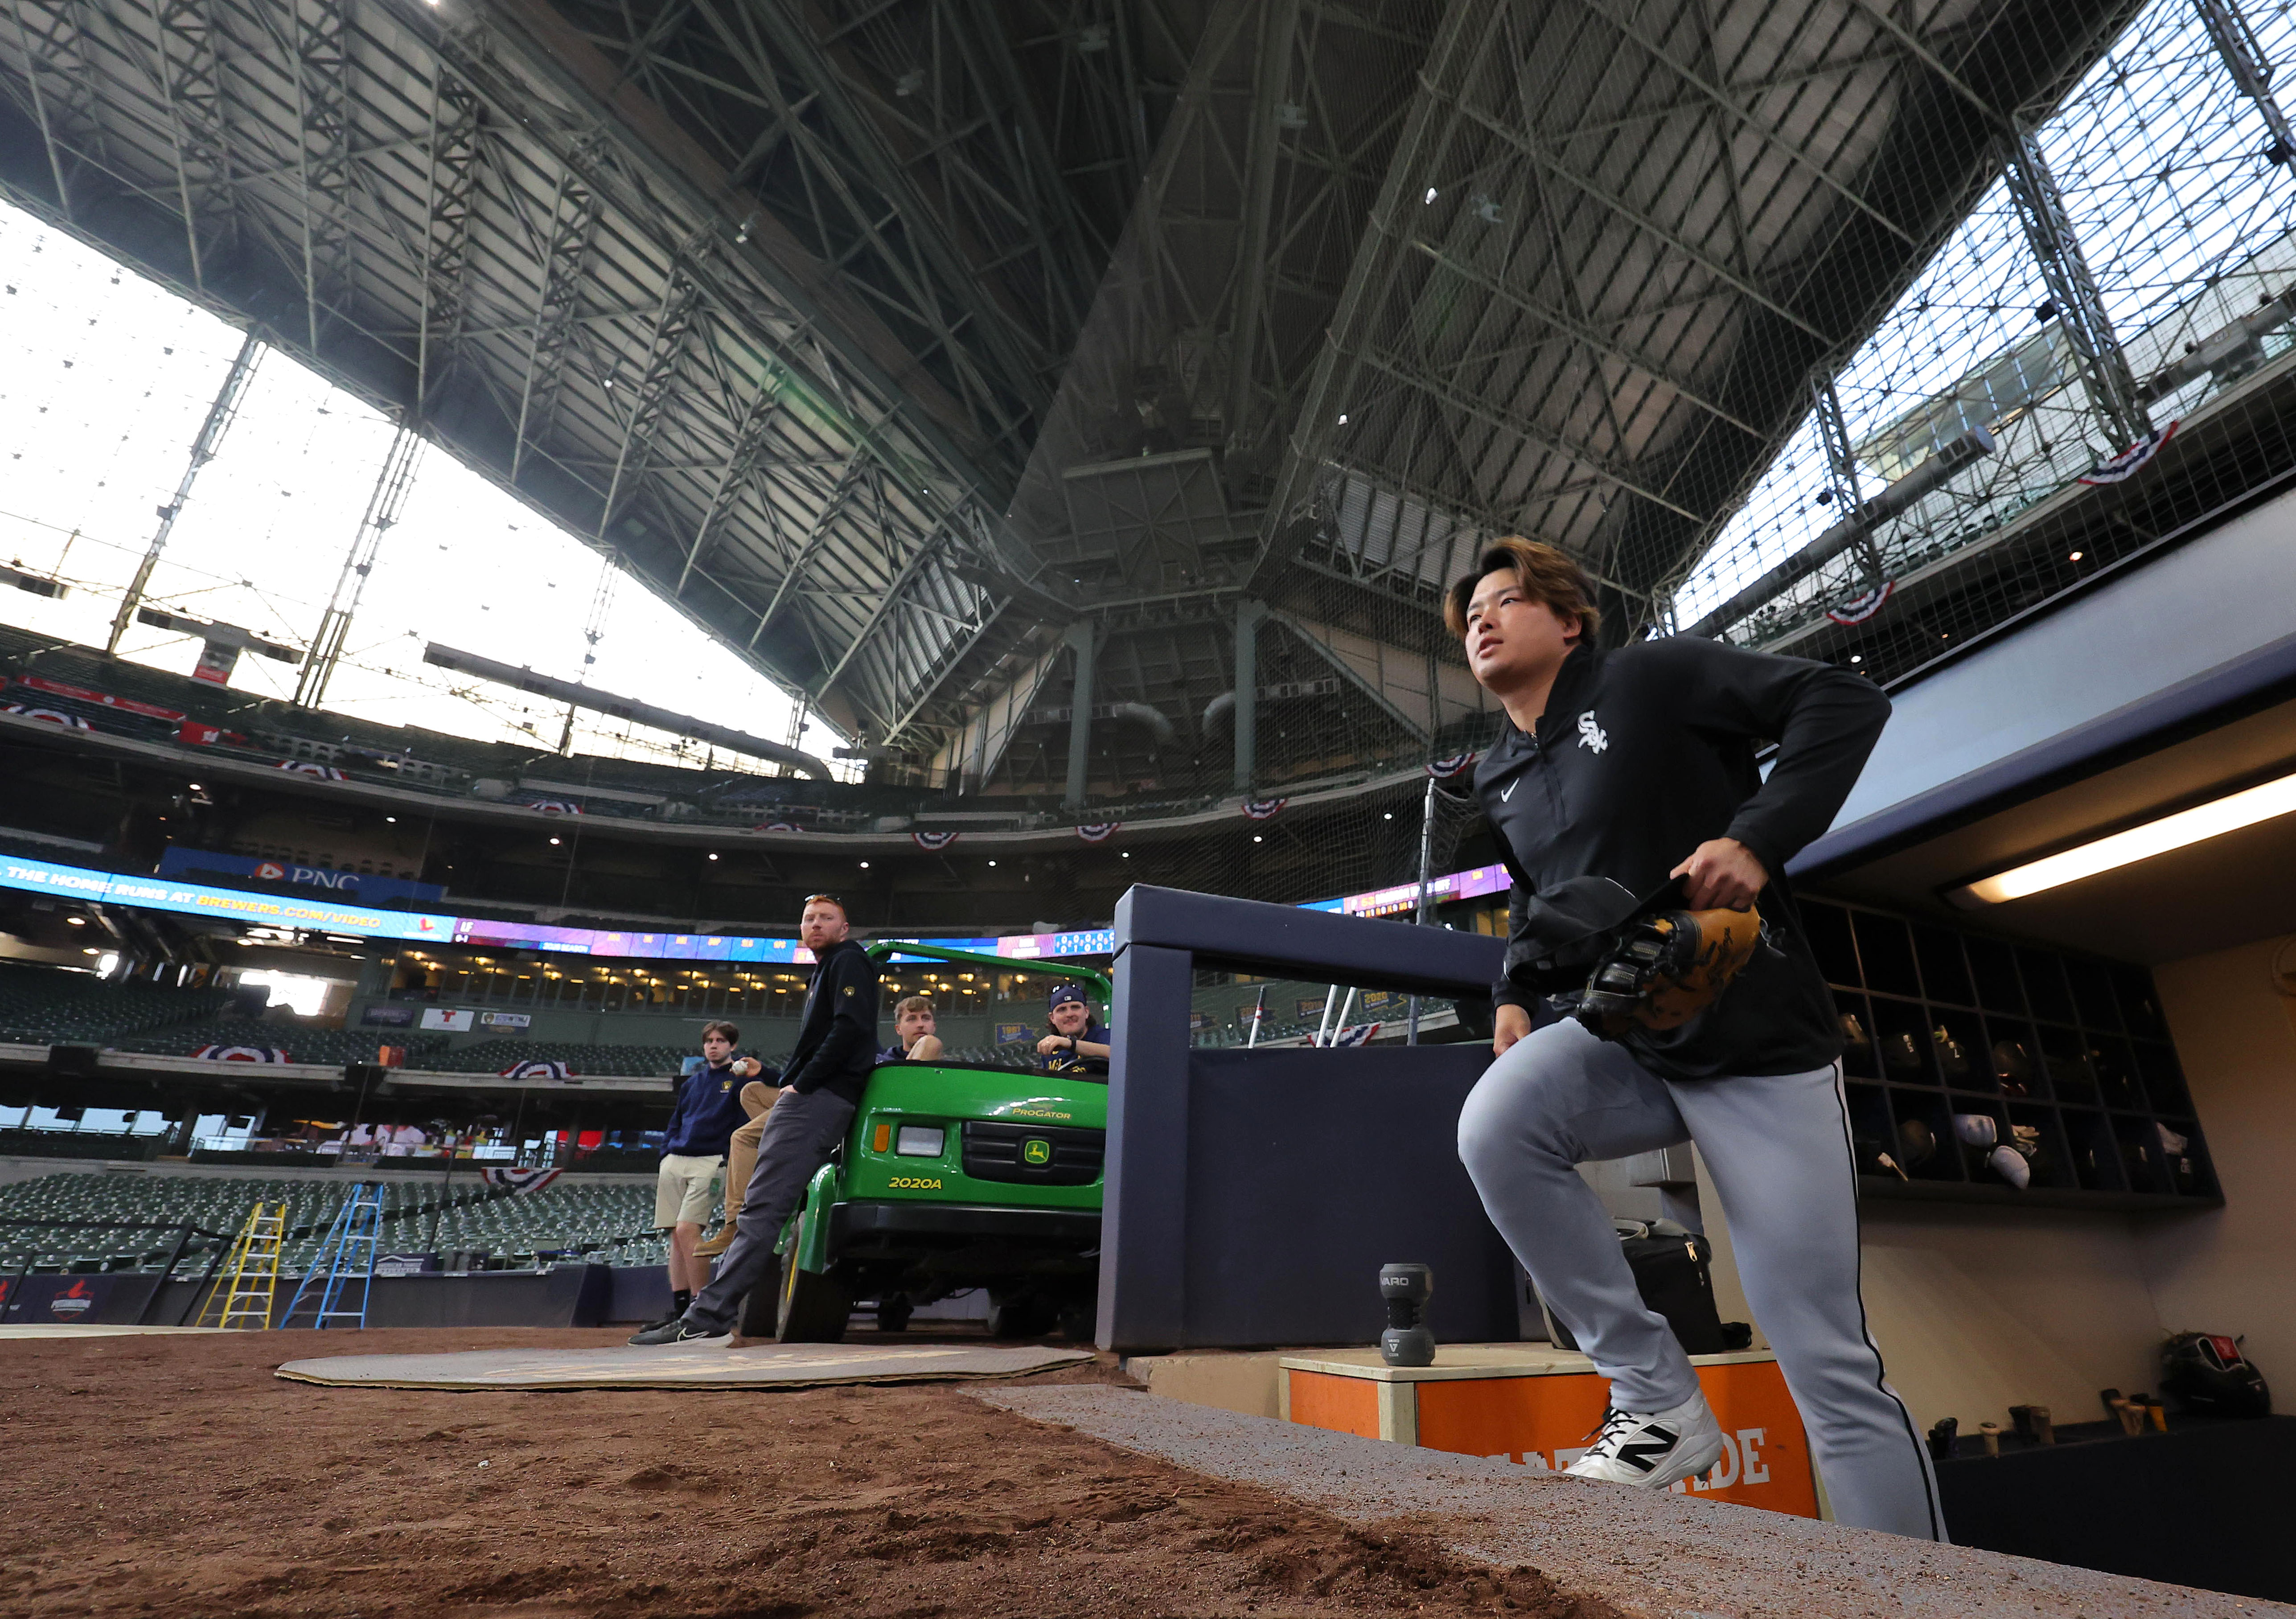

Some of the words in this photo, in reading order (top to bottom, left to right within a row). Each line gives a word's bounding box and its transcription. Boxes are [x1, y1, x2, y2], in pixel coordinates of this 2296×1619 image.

[292, 868, 359, 889] PNC
[7, 866, 49, 883] THE
[49, 874, 114, 894] HOME
[115, 884, 168, 900] RUNS
[168, 892, 195, 903] AT
[197, 895, 380, 928] BREWERS.COM/VIDEO
[460, 921, 474, 932] LF
[1062, 936, 1068, 944] 0
[1073, 935, 1079, 943] 0
[1085, 934, 1091, 942] 0
[1097, 933, 1103, 941] 0
[1061, 945, 1067, 954] 0
[1084, 943, 1091, 952] 0
[1097, 943, 1103, 951] 0
[888, 1177, 942, 1190] 2020A
